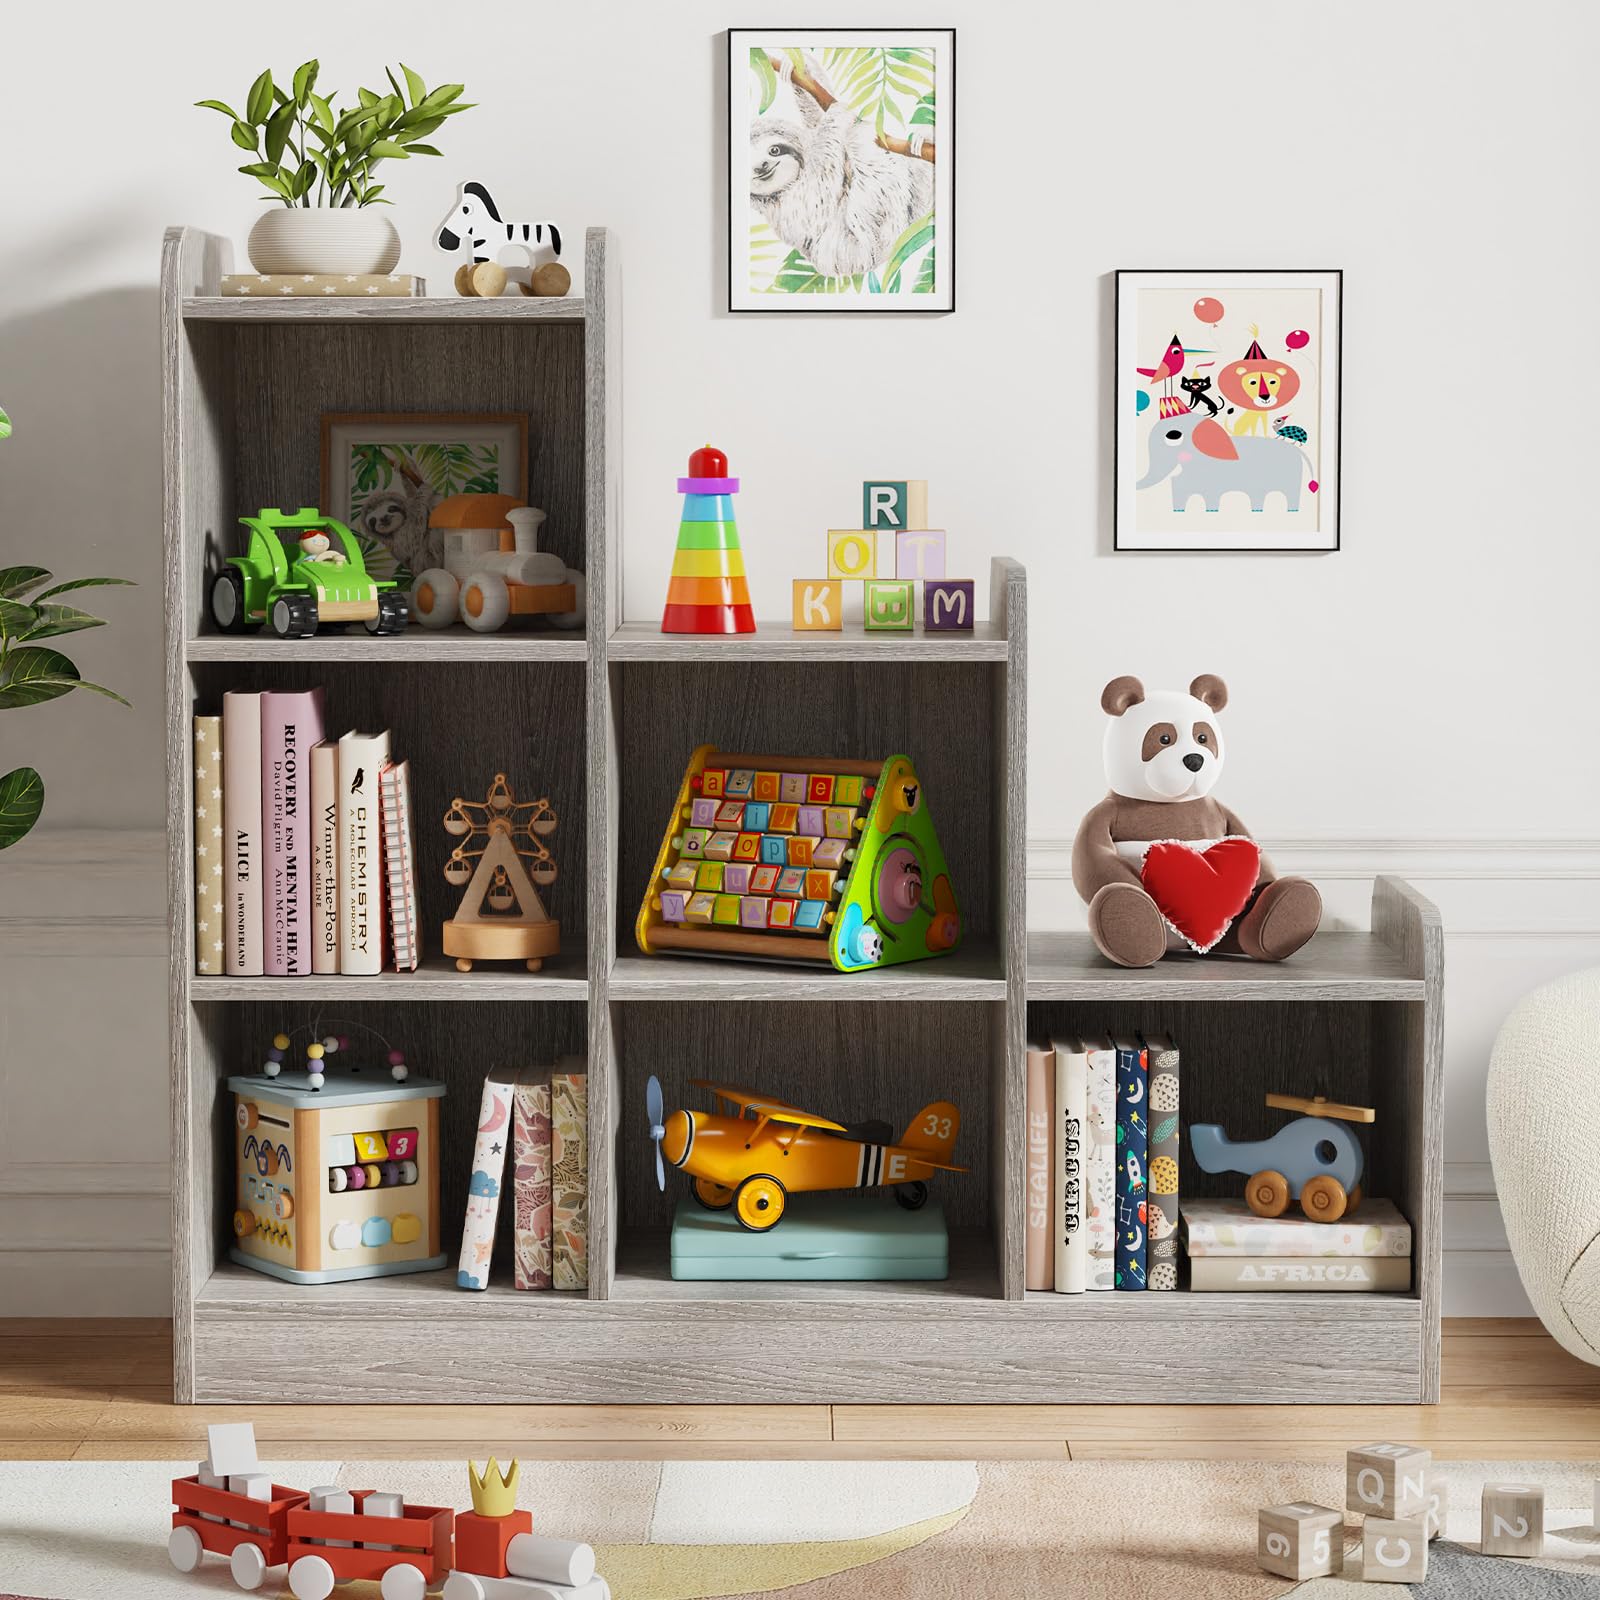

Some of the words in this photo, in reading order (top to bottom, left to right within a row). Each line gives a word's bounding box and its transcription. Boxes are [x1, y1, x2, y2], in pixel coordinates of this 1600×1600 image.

[870, 486, 900, 525] R
[833, 536, 870, 574] O
[904, 536, 940, 577] T
[802, 585, 830, 625] K
[871, 586, 909, 623] B
[933, 588, 967, 624] M
[274, 761, 283, 800] David
[284, 724, 297, 819] RECOVERY
[708, 776, 719, 794] a
[815, 783, 827, 796] e
[273, 804, 283, 853] Pilgrim
[350, 809, 355, 817] A
[699, 802, 710, 823] g
[237, 829, 249, 882] ALICE
[285, 827, 294, 851] END
[275, 868, 283, 895] Ann
[286, 855, 297, 927] MENTAL
[325, 802, 336, 953] Winnie-the-Pooh
[358, 807, 368, 954] CHEMISTRY
[237, 902, 246, 967] WONDERLAND
[275, 899, 284, 965] McCranie
[363, 1136, 379, 1155] 2
[395, 1137, 409, 1155] 3
[923, 1114, 952, 1139] 33
[888, 1154, 908, 1179] E
[1029, 1111, 1049, 1230] SEALIFE
[1064, 1118, 1080, 1234] CIRCUS
[1237, 1264, 1370, 1282] AFRICA
[1357, 1468, 1385, 1509] Q
[1493, 1513, 1529, 1538] 2
[1312, 1529, 1330, 1567] 5
[1375, 1536, 1412, 1567] C
